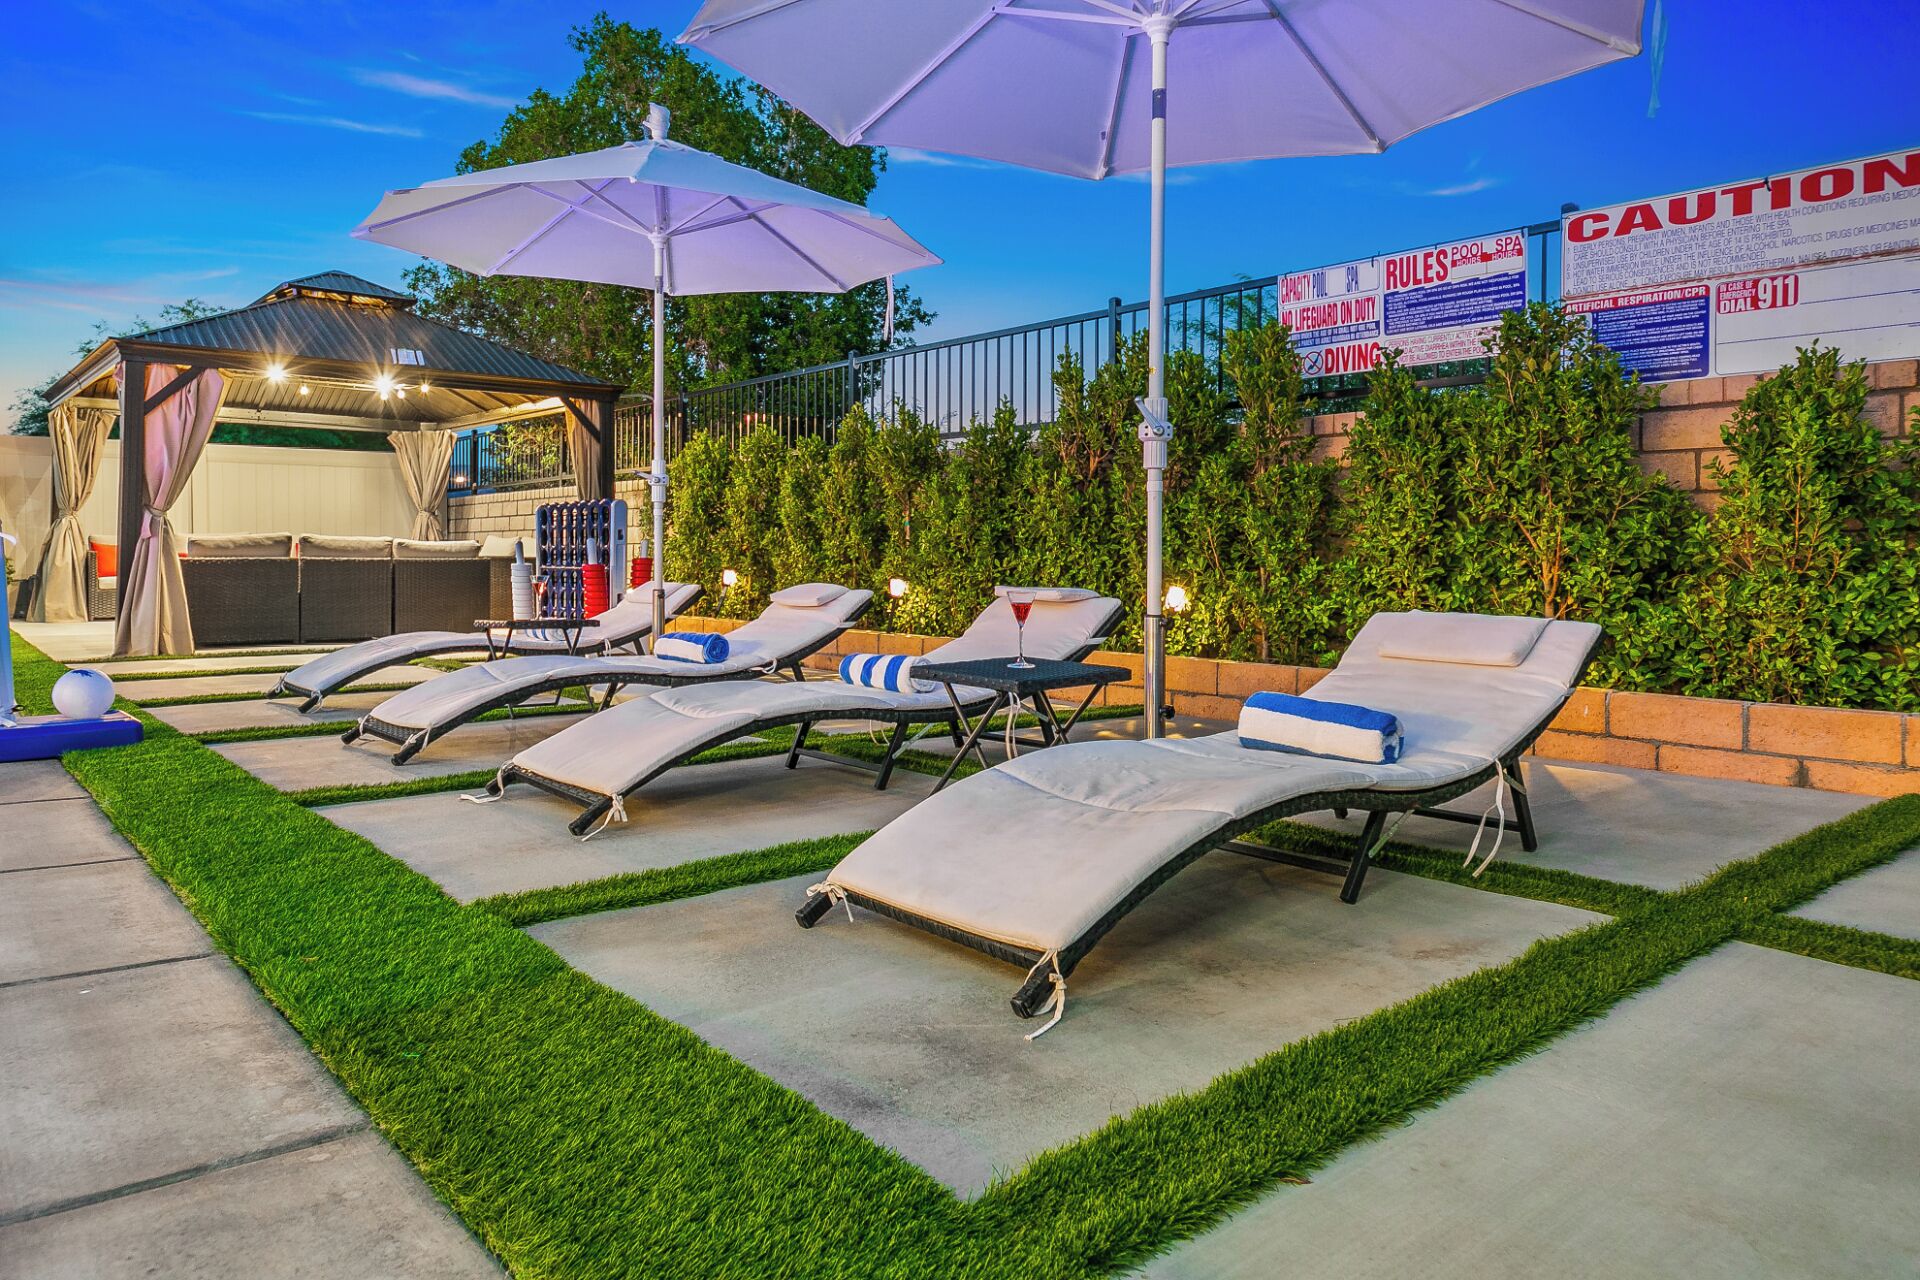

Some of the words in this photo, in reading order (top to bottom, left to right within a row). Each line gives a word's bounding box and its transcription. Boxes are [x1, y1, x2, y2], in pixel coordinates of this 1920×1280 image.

[1567, 153, 1920, 243] CAUTION
[1573, 242, 1597, 253] ELDERLY
[1627, 231, 1660, 243] PREGNANT
[1716, 219, 1730, 229] AND
[1732, 215, 1754, 226] THOSE
[1756, 213, 1772, 223] WITH
[1774, 207, 1800, 220] HEALTH
[1802, 200, 1847, 216] CONDITIONS
[1848, 192, 1891, 208] REQUIRING
[1451, 241, 1485, 260] POOL
[1495, 235, 1523, 253] SPA
[1456, 255, 1482, 267] HOURS
[1492, 249, 1518, 261] HOURS
[1572, 269, 1585, 279] HOT
[1586, 265, 1605, 276] WATER
[1606, 260, 1640, 274] IMMERSION
[1640, 257, 1658, 268] WHILE
[1660, 254, 1683, 266] UNDER
[1684, 252, 1695, 262] THE
[1697, 245, 1734, 259] INFLUENCE
[1736, 244, 1744, 254] OF
[1825, 229, 1852, 241] DRUGS
[1853, 226, 1864, 236] OR
[1866, 219, 1908, 235] MEDICINES
[1573, 252, 1590, 262] CARE
[1591, 248, 1614, 259] SHOULD
[1614, 244, 1641, 257] CONSULT
[1642, 241, 1659, 251] WITH
[1659, 239, 1664, 248] A
[1665, 233, 1699, 246] PHYSICIAN
[1700, 229, 1726, 241] BEFORE
[1728, 223, 1761, 236] ENTERING
[1763, 221, 1776, 230] THE
[1573, 255, 1617, 270] UNSUPERVISED
[1618, 253, 1628, 262] USE
[1629, 251, 1639, 261] BY
[1640, 246, 1670, 259] CHILDREN
[1671, 243, 1692, 254] UNDER
[1695, 241, 1708, 250] THE
[1708, 238, 1722, 248] AGE
[1723, 237, 1733, 247] OF
[1735, 236, 1742, 245] 14
[1743, 235, 1750, 244] IS
[1281, 274, 1311, 304] CAPACITY
[1312, 271, 1328, 299] POOL
[1346, 264, 1359, 293] SPA
[1385, 248, 1449, 290] RULES
[1573, 277, 1587, 287] LEAD
[1588, 275, 1597, 285] TO
[1598, 271, 1623, 283] SERIOUS
[1624, 264, 1675, 279] CONSEQUENCES
[1676, 262, 1690, 272] AND
[1690, 260, 1697, 270] IS
[1698, 258, 1711, 269] NOT
[1597, 281, 1608, 291] USE
[1694, 264, 1707, 277] MAY
[1709, 260, 1732, 275] RESULT
[1734, 259, 1741, 269] IN
[1870, 242, 1882, 251] OR
[1565, 299, 1615, 314] ARTIFICIAL
[1617, 286, 1706, 307] RESPIRATION/CPR
[1719, 284, 1728, 293] IN
[1728, 281, 1744, 291] CASE
[1745, 280, 1754, 289] OF
[1719, 288, 1756, 301] EMERGENCY
[1719, 298, 1756, 314] DIAL
[1757, 275, 1796, 309] 911
[1281, 309, 1292, 332] NO
[1294, 302, 1338, 332] LIFEGUARD
[1340, 299, 1352, 325] ON
[1354, 296, 1376, 323] DUTY
[1324, 341, 1381, 375] DIVING
